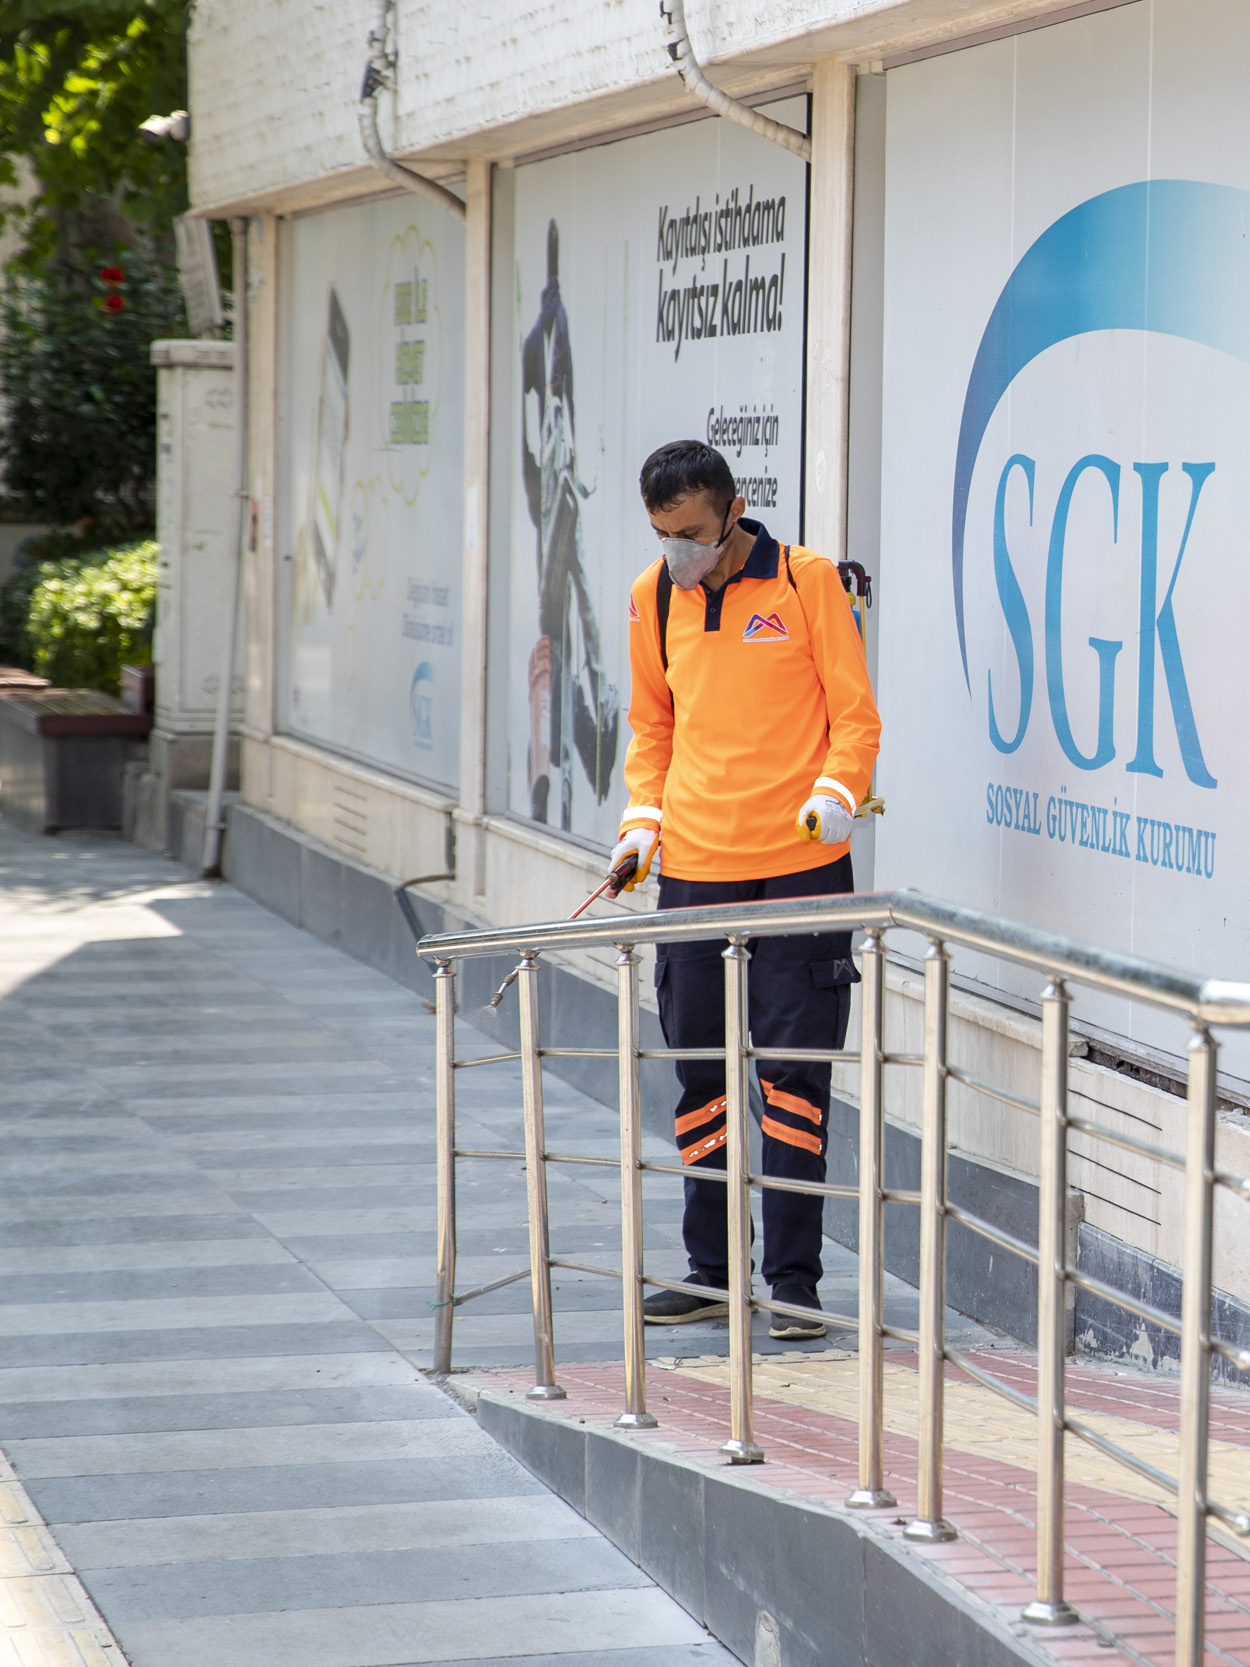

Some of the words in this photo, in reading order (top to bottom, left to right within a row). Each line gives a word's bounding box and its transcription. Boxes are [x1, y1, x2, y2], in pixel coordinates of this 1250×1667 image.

[713, 184, 786, 253] istihdama
[656, 268, 719, 363] kayıtsız
[720, 252, 785, 337] kalma!
[707, 405, 761, 457] Geleceğiniz
[761, 403, 779, 457] için
[733, 465, 778, 508] encenize
[988, 453, 1218, 789] SGK
[986, 782, 1042, 836] SOSYAL
[1046, 784, 1131, 859] GÜVENLİK
[1135, 815, 1217, 880] KURUMU
